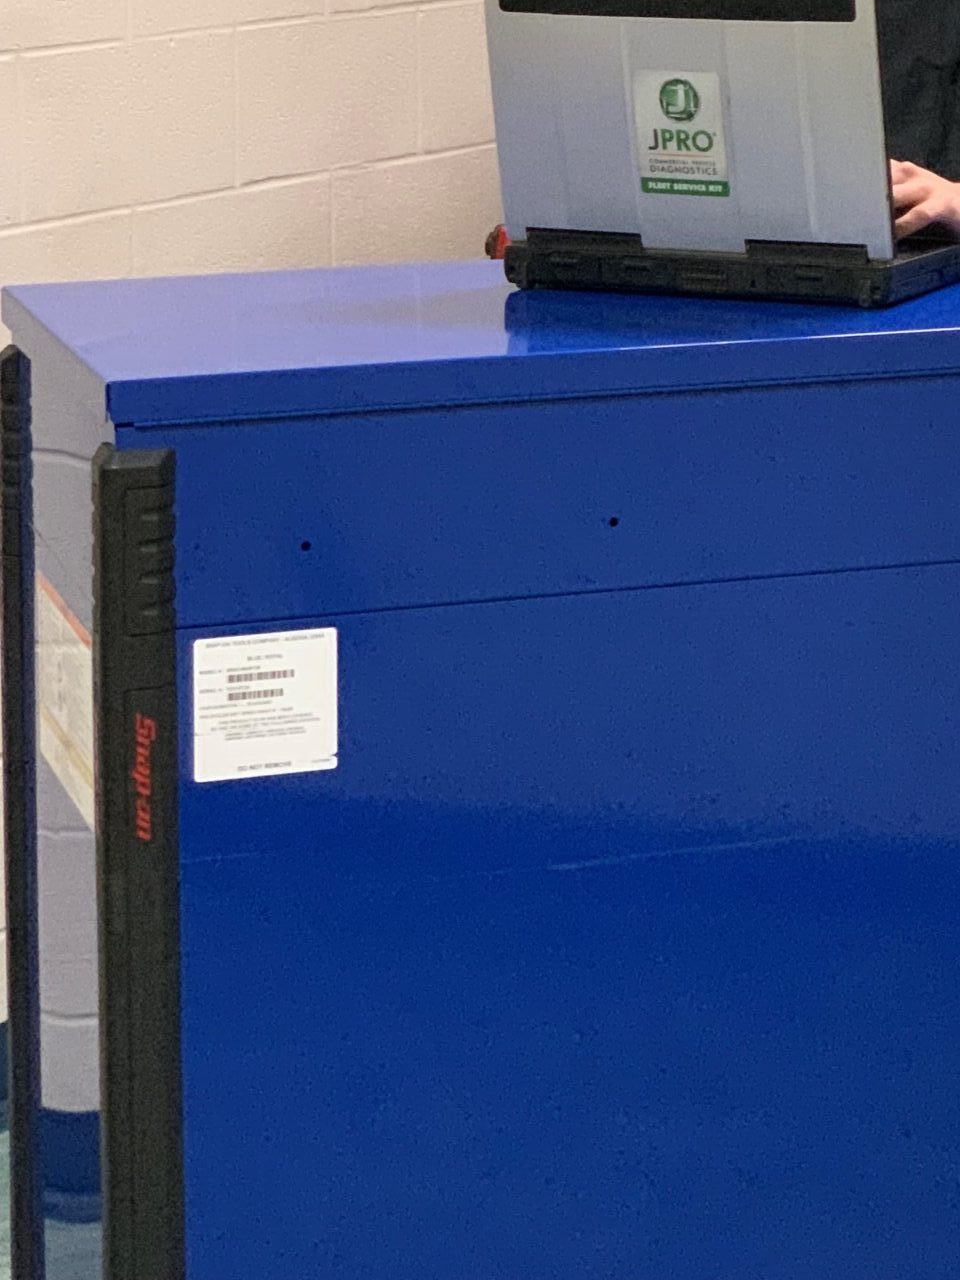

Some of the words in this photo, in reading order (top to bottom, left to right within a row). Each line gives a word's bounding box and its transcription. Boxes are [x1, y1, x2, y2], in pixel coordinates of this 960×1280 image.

[648, 128, 714, 152] JPRO
[649, 165, 718, 176] DIAGNOSTICS
[648, 181, 671, 190] FLEET
[673, 183, 706, 192] SERVICE
[708, 184, 723, 193] KIT
[132, 713, 157, 841] Snap-on
